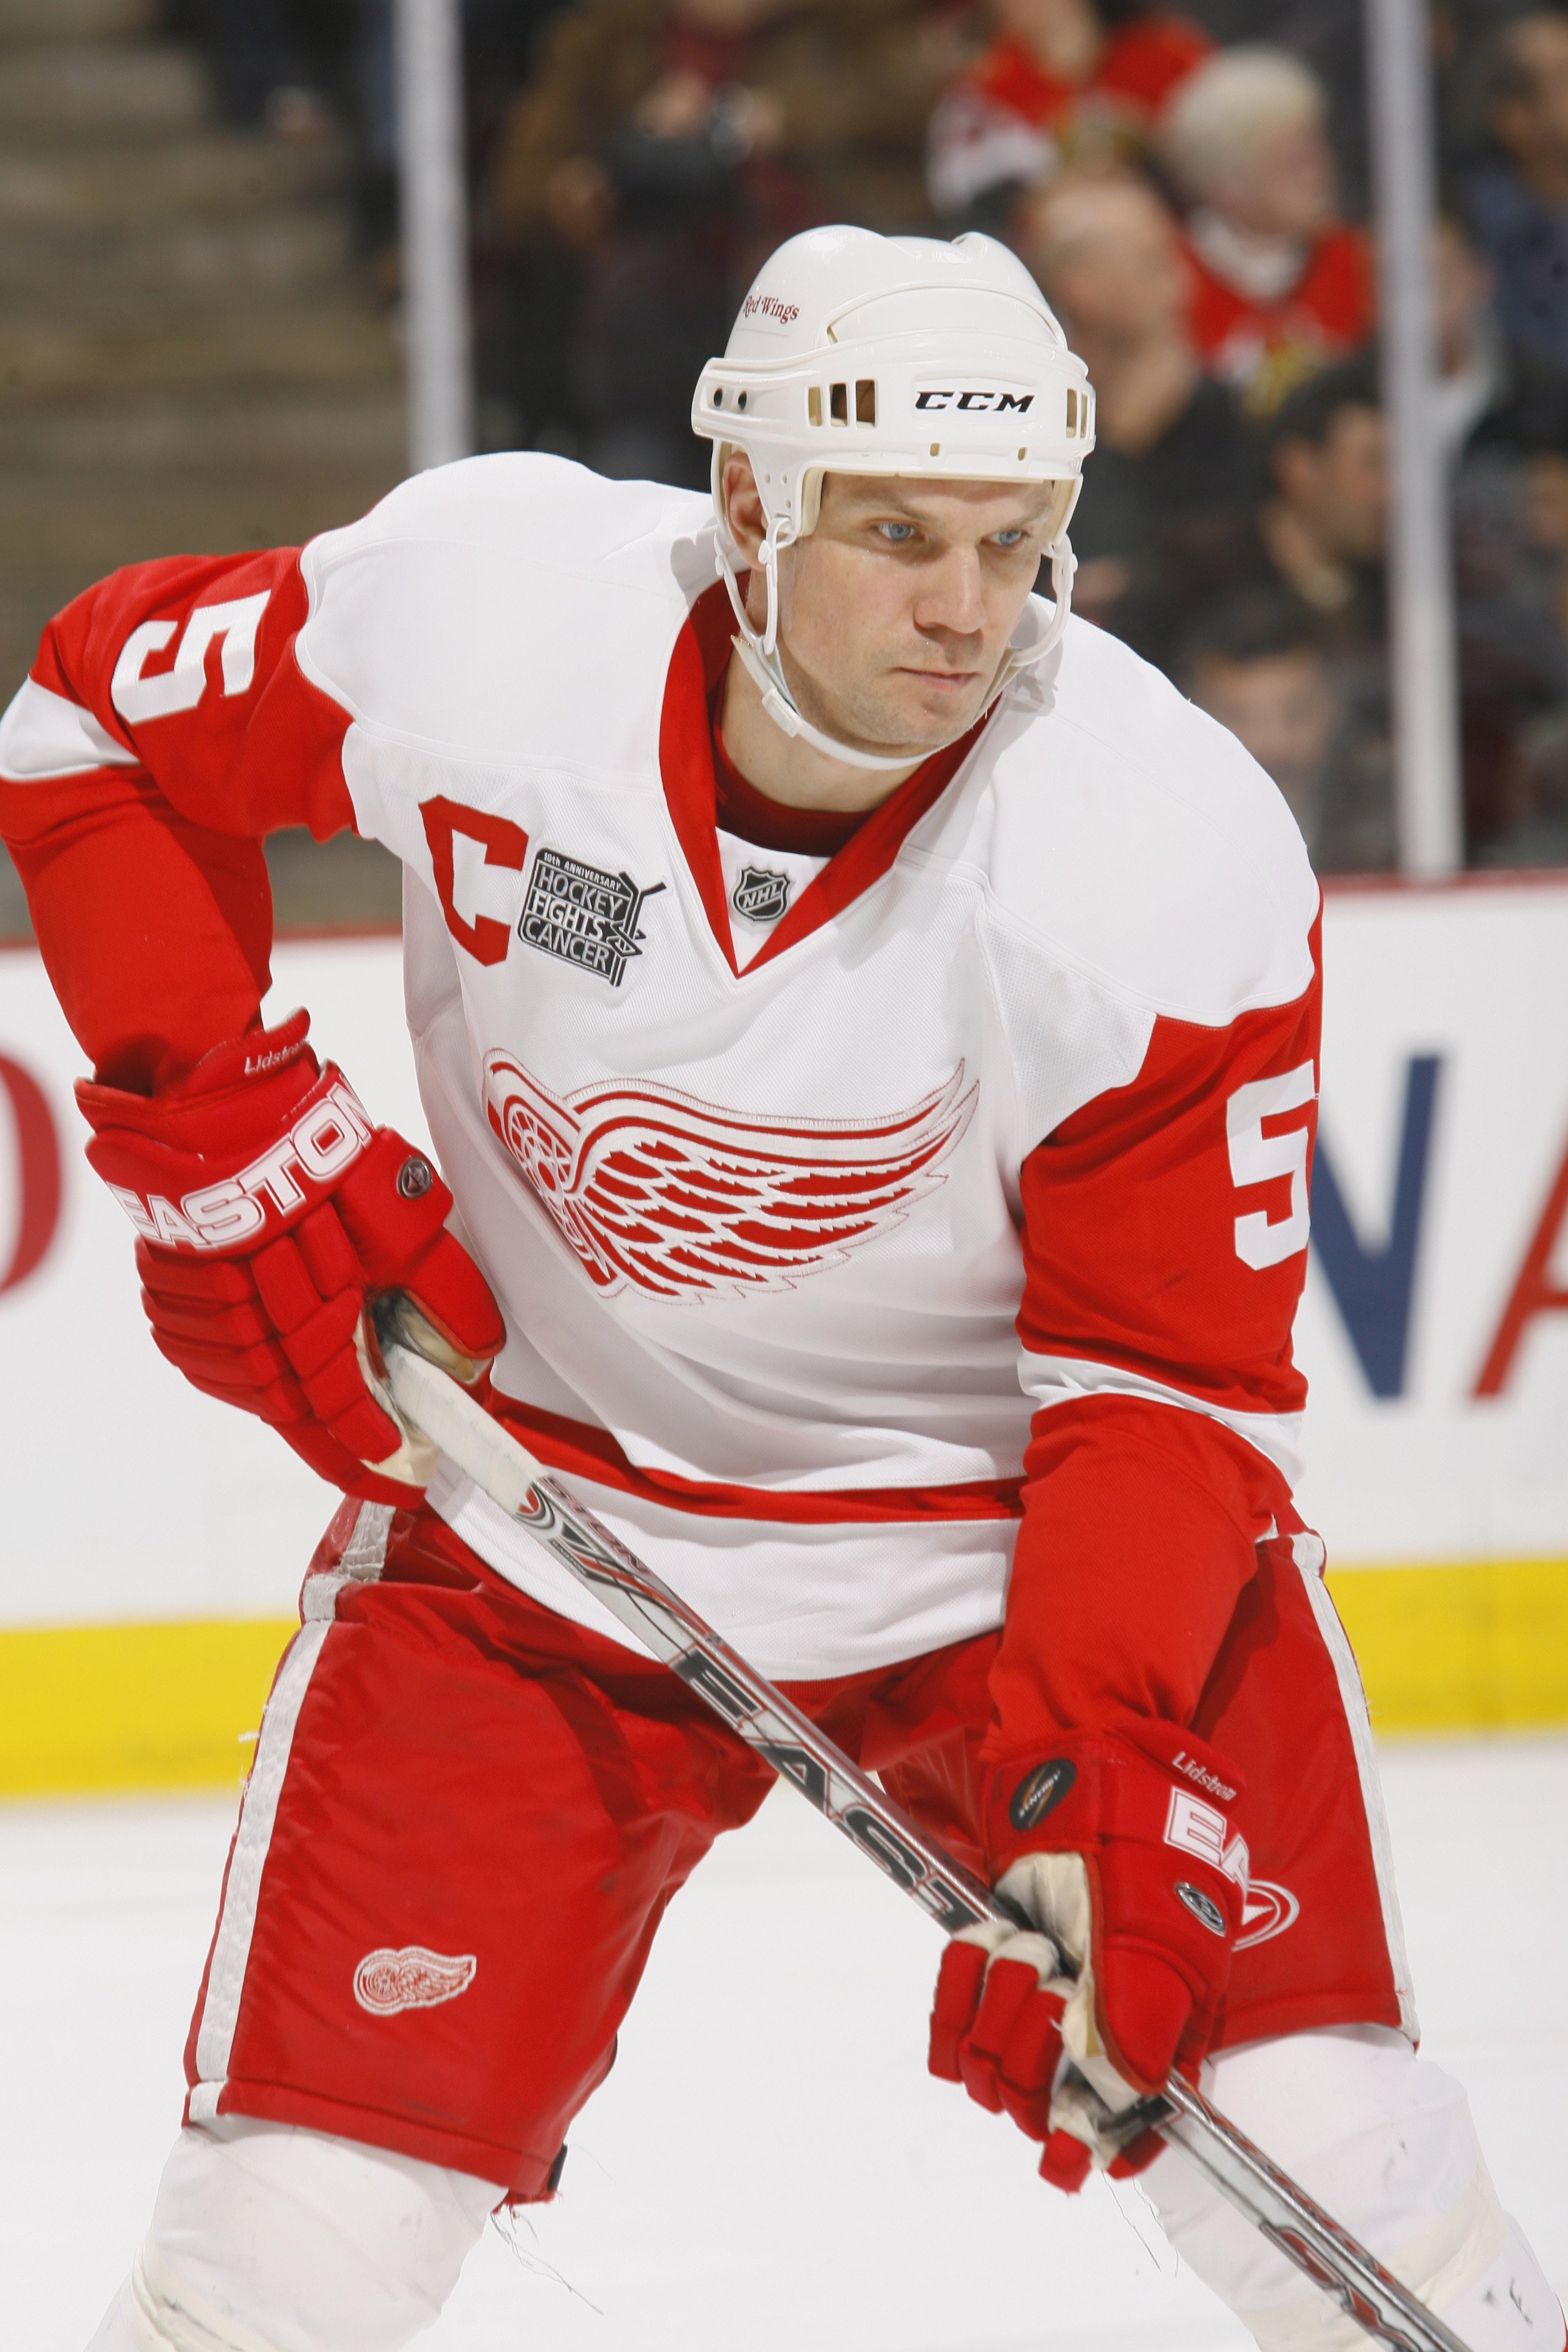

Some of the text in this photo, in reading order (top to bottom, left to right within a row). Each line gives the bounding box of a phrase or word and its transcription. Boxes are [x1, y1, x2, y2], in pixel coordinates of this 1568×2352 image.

[761, 295, 800, 324] Wings
[915, 389, 1036, 413] CCM
[110, 588, 271, 726] 5
[418, 793, 530, 967] C
[538, 865, 624, 920] HOCKEY
[544, 851, 622, 892] 10th ANNIVERSARY
[741, 883, 781, 909] NHL
[526, 915, 610, 972] CANCER
[531, 892, 606, 941] FIGHTS
[105, 1075, 373, 1252] EASTON
[1226, 1058, 1320, 1271] 5
[1171, 1749, 1237, 1802] Lidstrom
